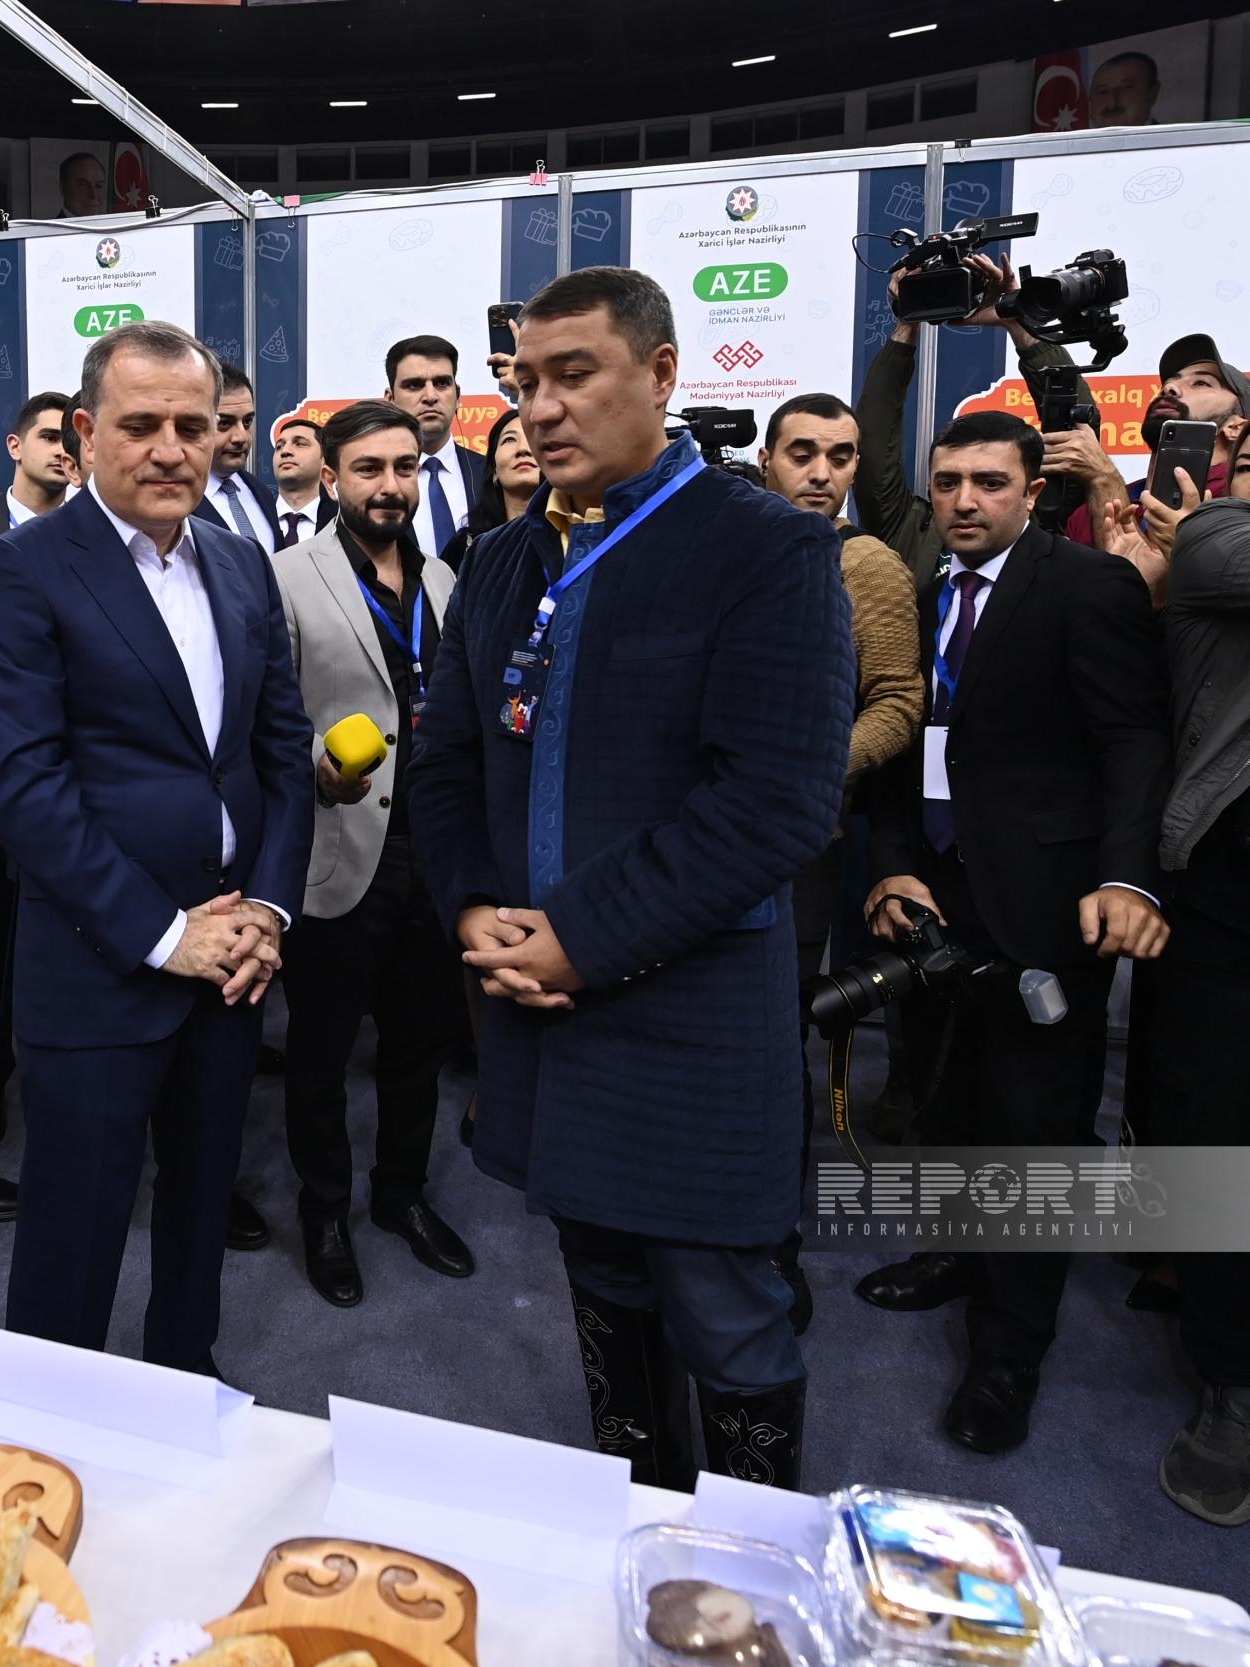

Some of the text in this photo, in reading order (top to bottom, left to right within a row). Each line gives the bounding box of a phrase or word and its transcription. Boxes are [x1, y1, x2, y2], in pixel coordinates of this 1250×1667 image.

[678, 224, 807, 239] Azərbaycan Respublikasının
[698, 234, 786, 248] Xarici İşlər Nazirliyi
[709, 269, 771, 296] AZE
[86, 310, 132, 333] AZE
[680, 378, 797, 391] Azərbaycan Respublikası
[690, 388, 786, 401] Mədəniyyət Nazirliyi
[833, 1088, 845, 1131] Nikon
